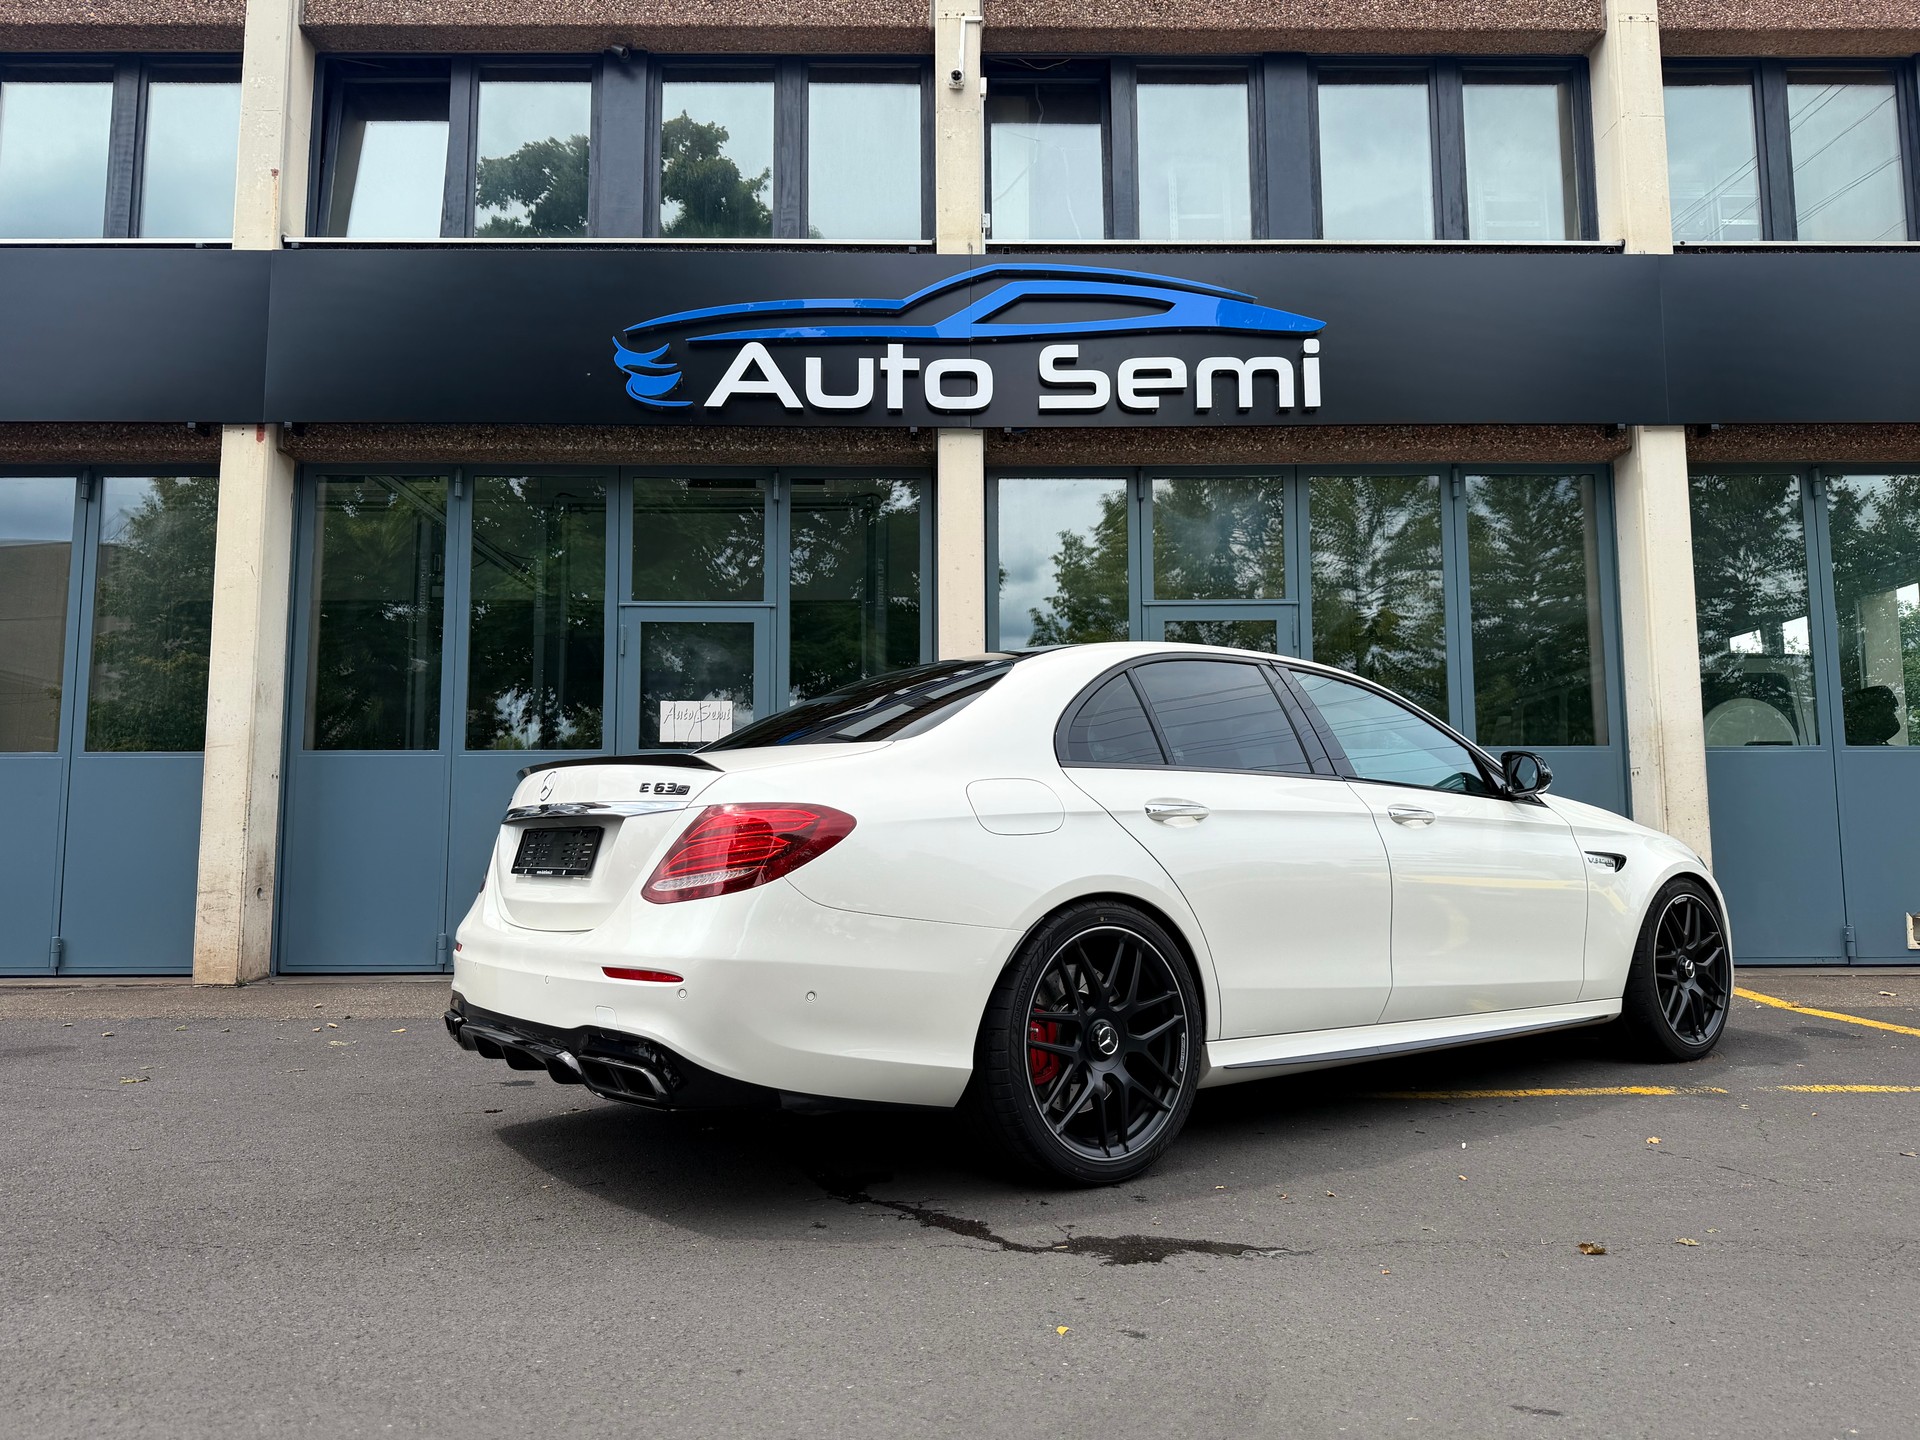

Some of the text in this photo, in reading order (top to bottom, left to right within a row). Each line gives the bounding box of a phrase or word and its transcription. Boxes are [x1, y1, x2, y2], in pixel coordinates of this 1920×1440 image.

[703, 338, 1321, 411] Auto Semi
[639, 782, 651, 793] E
